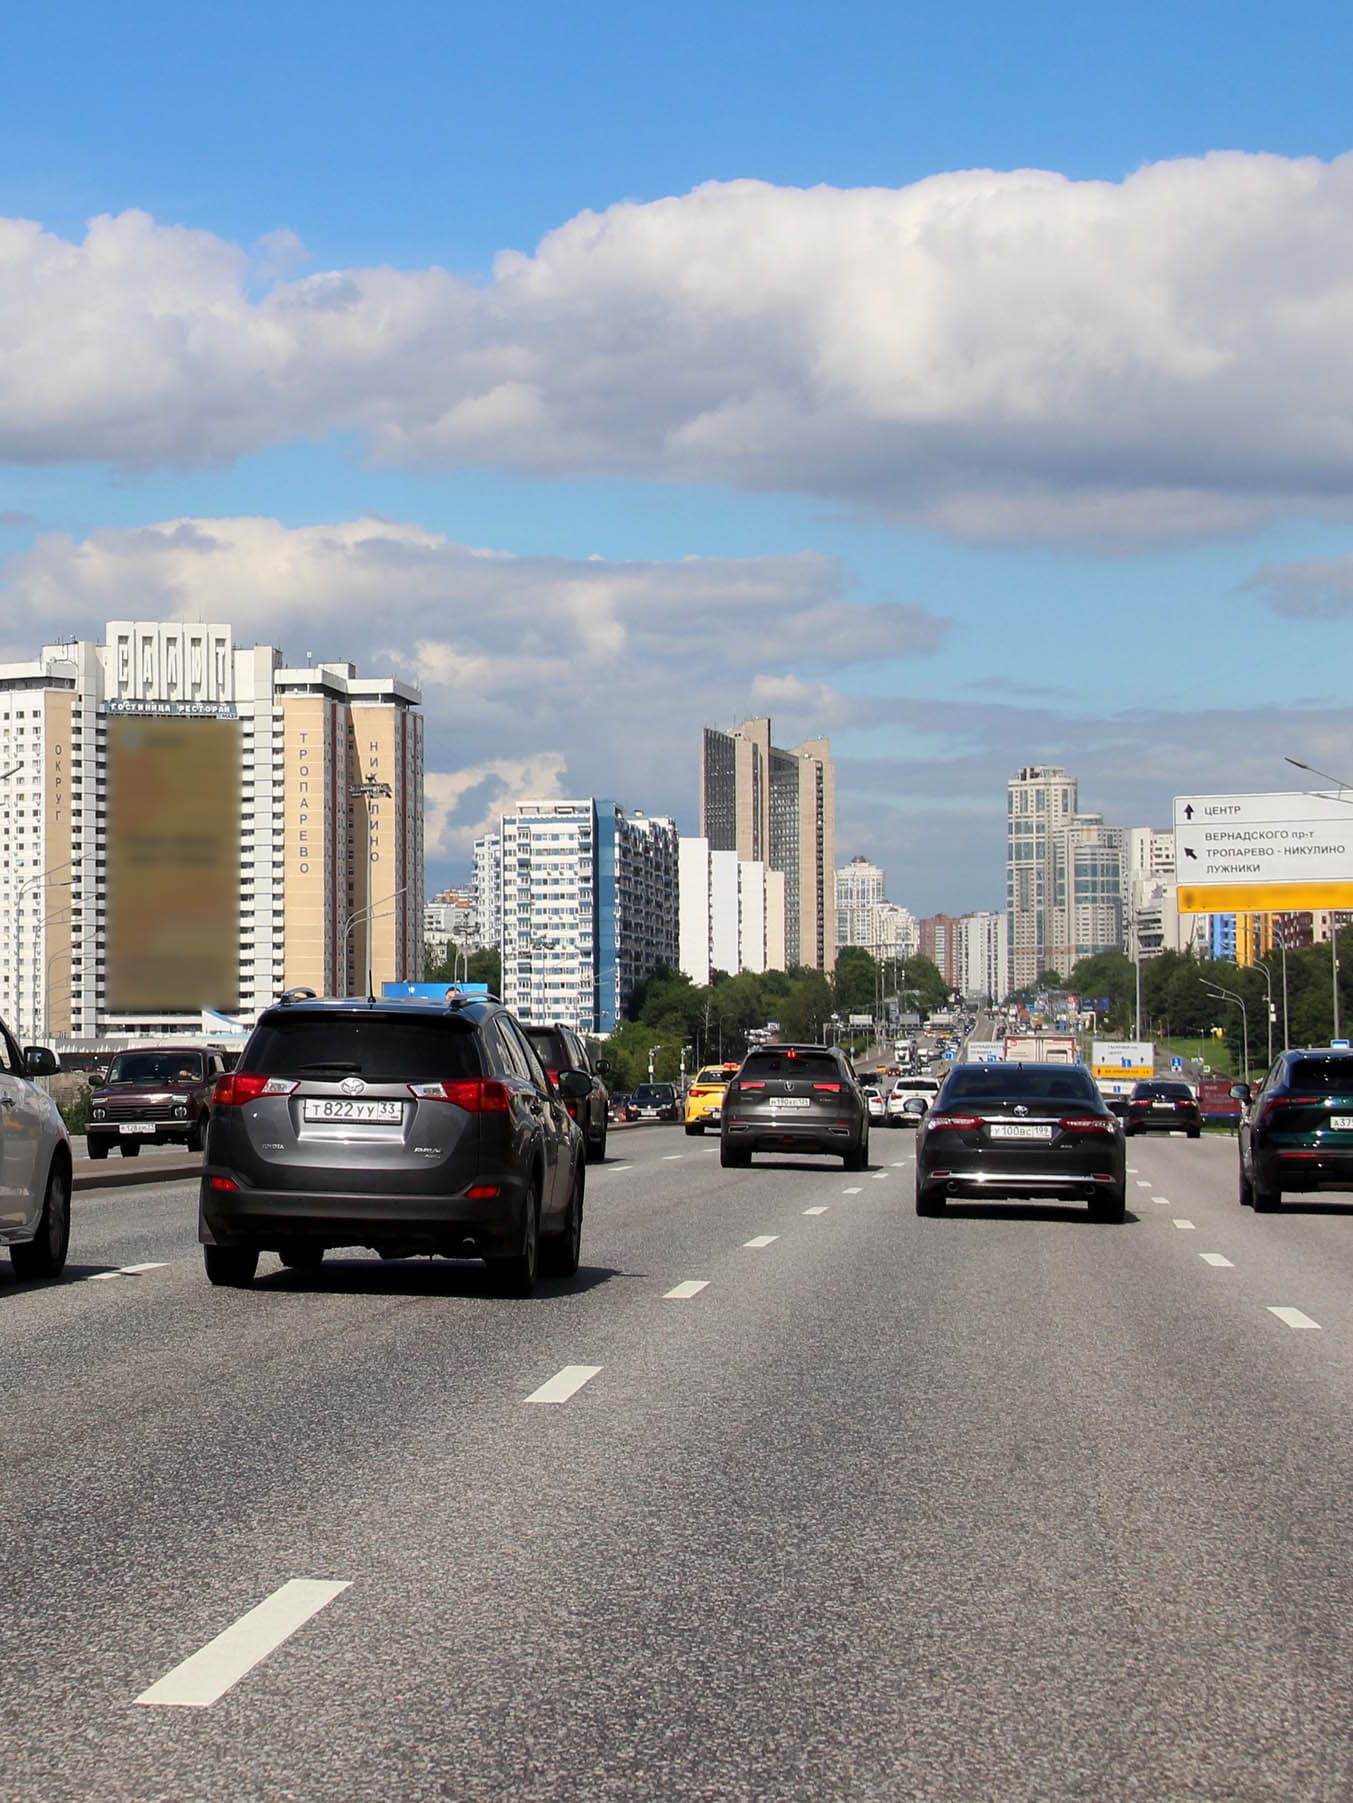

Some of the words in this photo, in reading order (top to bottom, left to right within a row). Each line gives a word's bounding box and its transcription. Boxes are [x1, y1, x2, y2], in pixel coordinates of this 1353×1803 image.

[110, 703, 171, 713] ГОСТИНИЦА
[178, 703, 231, 713] РЕСТОРАН
[54, 744, 62, 818] ОКРУГ
[299, 733, 309, 873] ТРОПАРЕВО
[369, 741, 380, 862] НИКЛИНО
[1204, 806, 1241, 816] ЦЕНТР
[1205, 830, 1289, 842] ВЕРНАДСКОГО
[1291, 831, 1314, 840] пр-т
[1206, 847, 1274, 858] ТРОПАРЕВО
[1284, 845, 1346, 856] НИКУЛИНО
[1205, 864, 1261, 874] ЛУЖНИКИ
